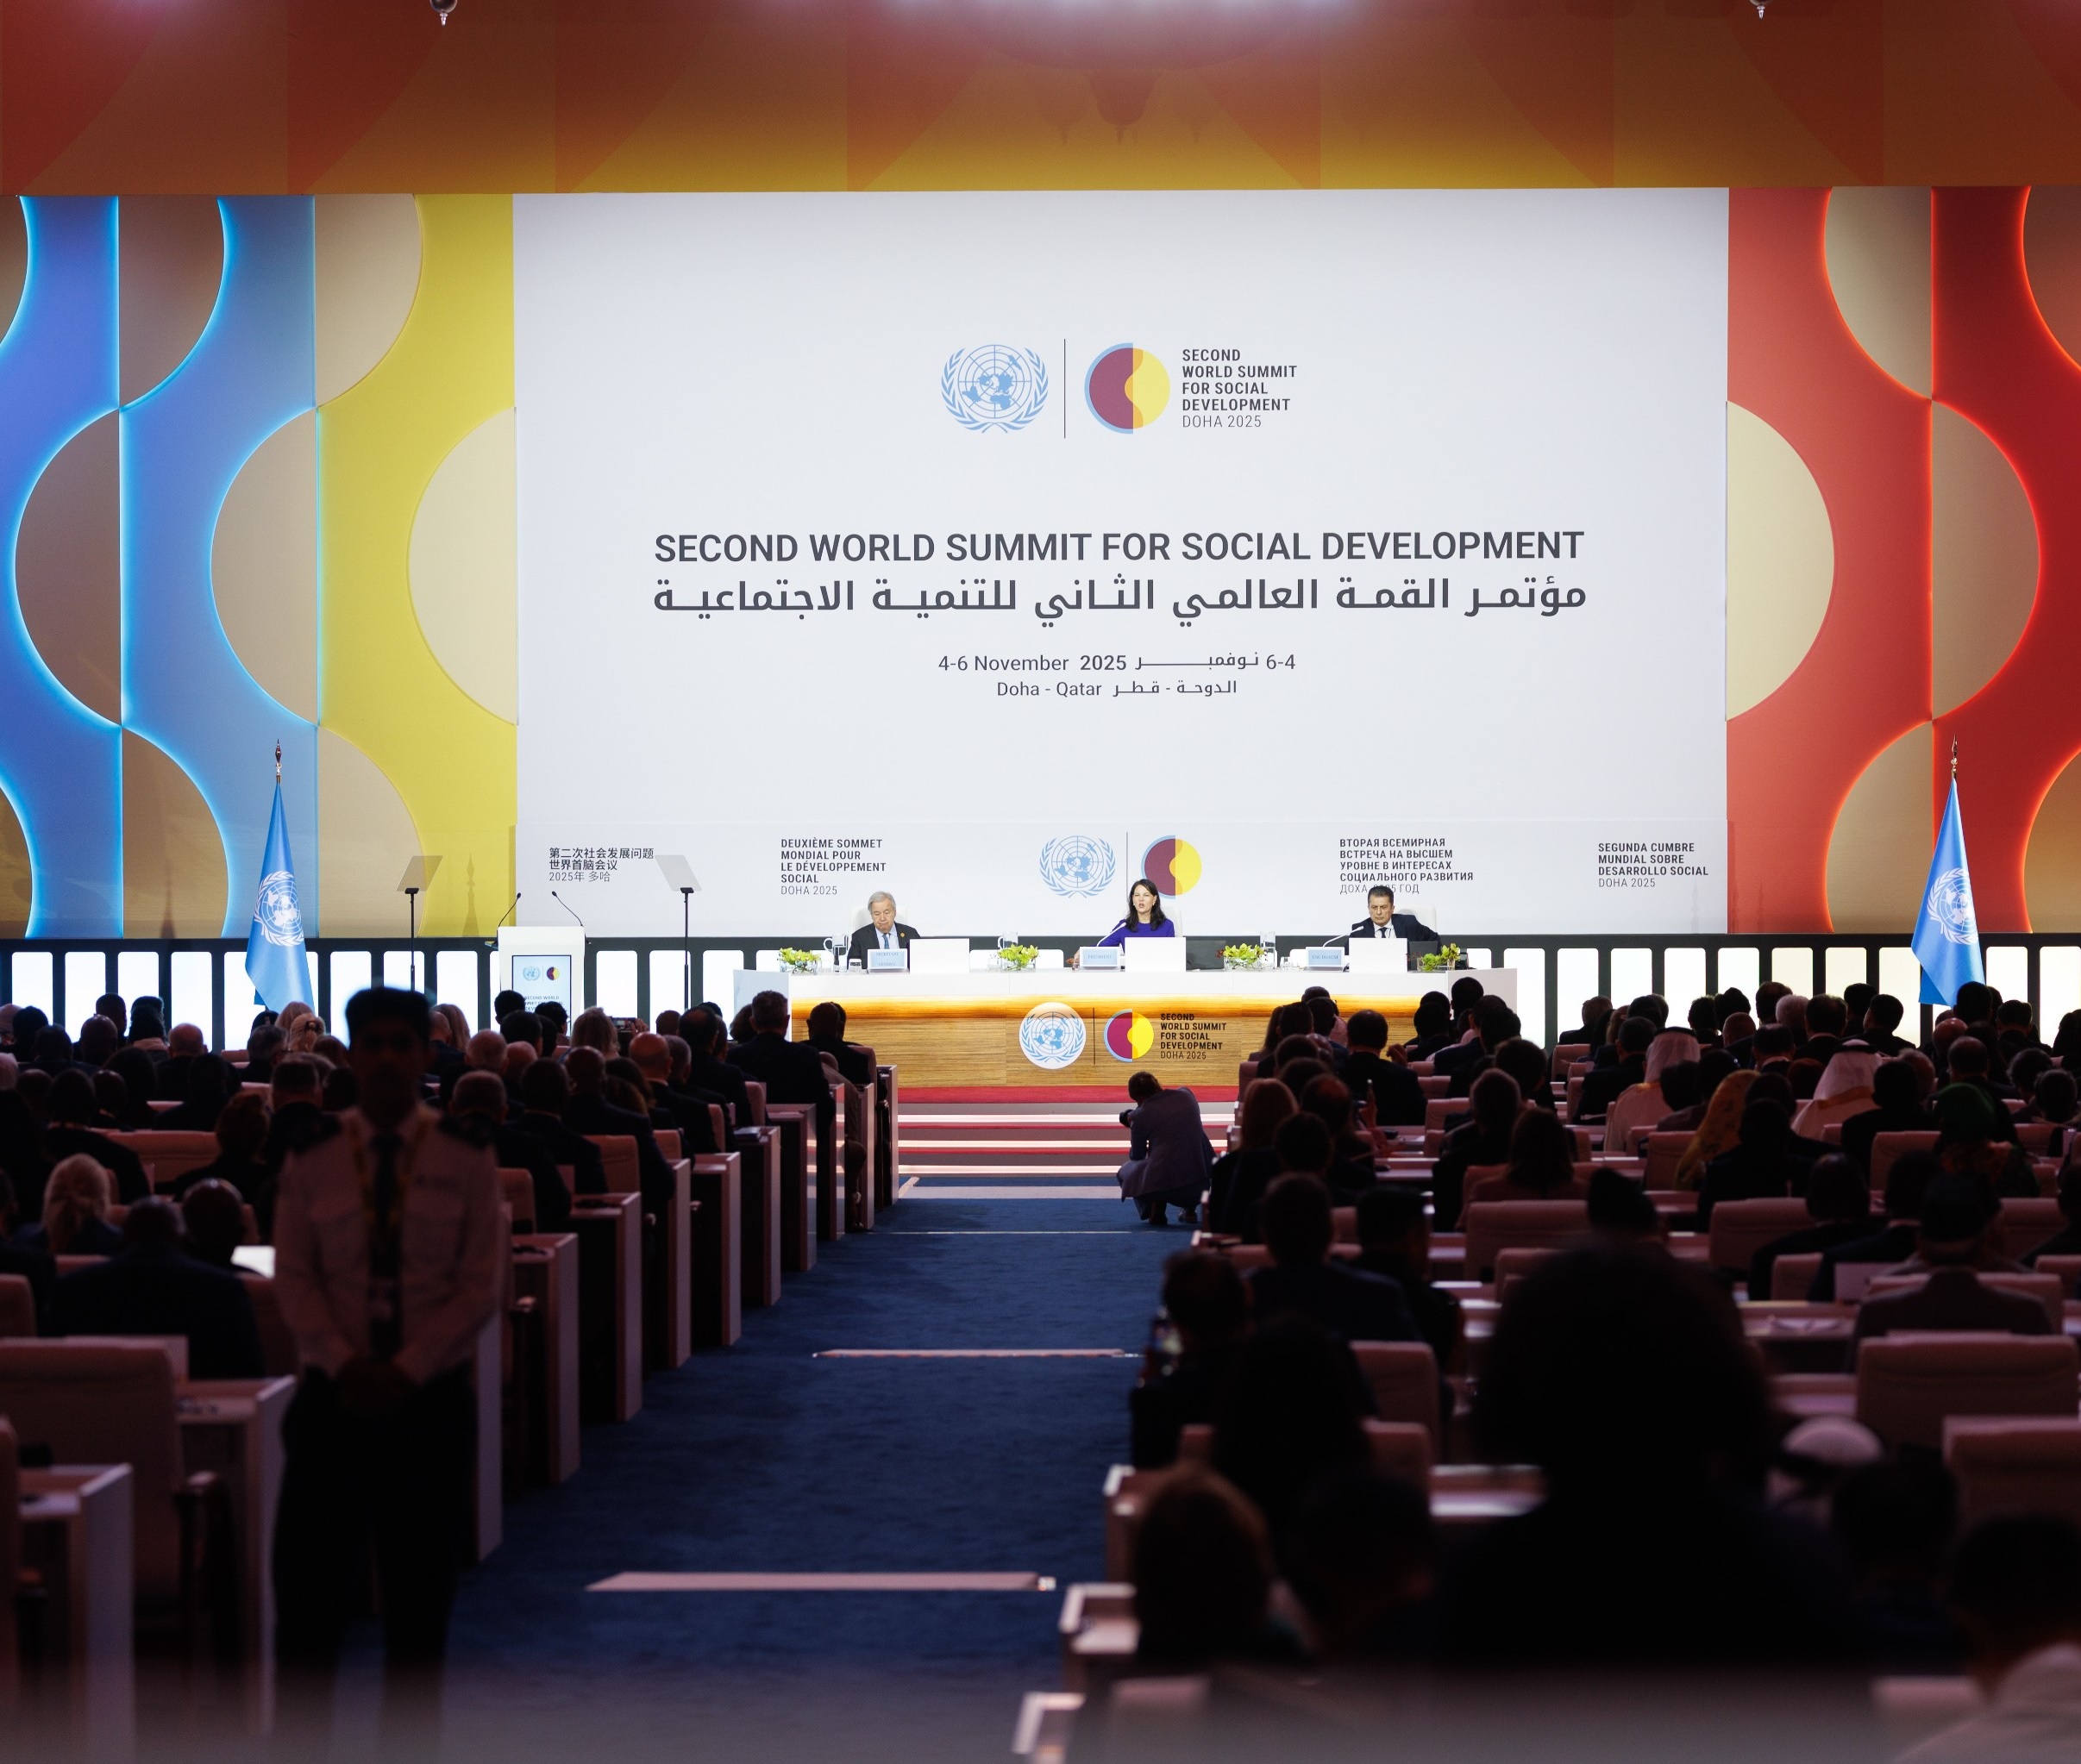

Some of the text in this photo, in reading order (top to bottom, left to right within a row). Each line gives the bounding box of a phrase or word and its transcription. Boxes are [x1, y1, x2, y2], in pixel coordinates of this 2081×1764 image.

[1182, 348, 1241, 362] SECOND
[1182, 365, 1298, 378] WORLD SUMMIT
[1182, 381, 1269, 395] FOR SOCIAL
[1182, 398, 1291, 411] DEVELOPMENT
[1182, 415, 1262, 428] DOHA 2025
[655, 530, 1585, 563] SECOND WORLD SUMMIT FOR SOCIAL DEVELOPMENT
[654, 572, 1586, 629] مؤتمر القمة العالمي الثاني للتنمية الاجتماعية
[938, 654, 1127, 672] 4-6 November 2025
[1134, 651, 1259, 671] نوفمبر
[997, 680, 1040, 697] Doha
[1056, 681, 1102, 698] Qatar
[1112, 680, 1160, 697] قطر
[1176, 679, 1237, 697] الدوحة
[780, 836, 883, 848] DEUXIÈME SOMMET
[1339, 838, 1445, 848] ВТОРАЯ ВСЕМИРНАЯ
[1598, 842, 1695, 853] SEGUNDA CUMBRE
[548, 847, 655, 860] 第二次社会发展问题
[780, 850, 861, 861] MONDIAL POUR
[1339, 849, 1453, 859] ВСТРЕЧА НА ВЫСШЕМ
[1598, 854, 1684, 864] MUNDIAL SOBRE
[548, 859, 617, 871] 世界首脑会议
[780, 860, 887, 872] LE DÉVELOPPEMENT
[1339, 860, 1451, 871] УРОВНЕ В ИНТЕРЕСАХ
[1598, 866, 1709, 876] DESARROLLO SOCIAL
[548, 871, 611, 883] 2025年 多哈
[780, 873, 819, 884] SOCIAL
[1339, 872, 1474, 884] СОЦИАЛЬНОГО РАЗВИТИЯ
[1598, 878, 1656, 888] DOHA 2025
[780, 885, 837, 896] DOHA 2025
[1399, 884, 1420, 895] ГОД
[1186, 1051, 1207, 1060] 2025
